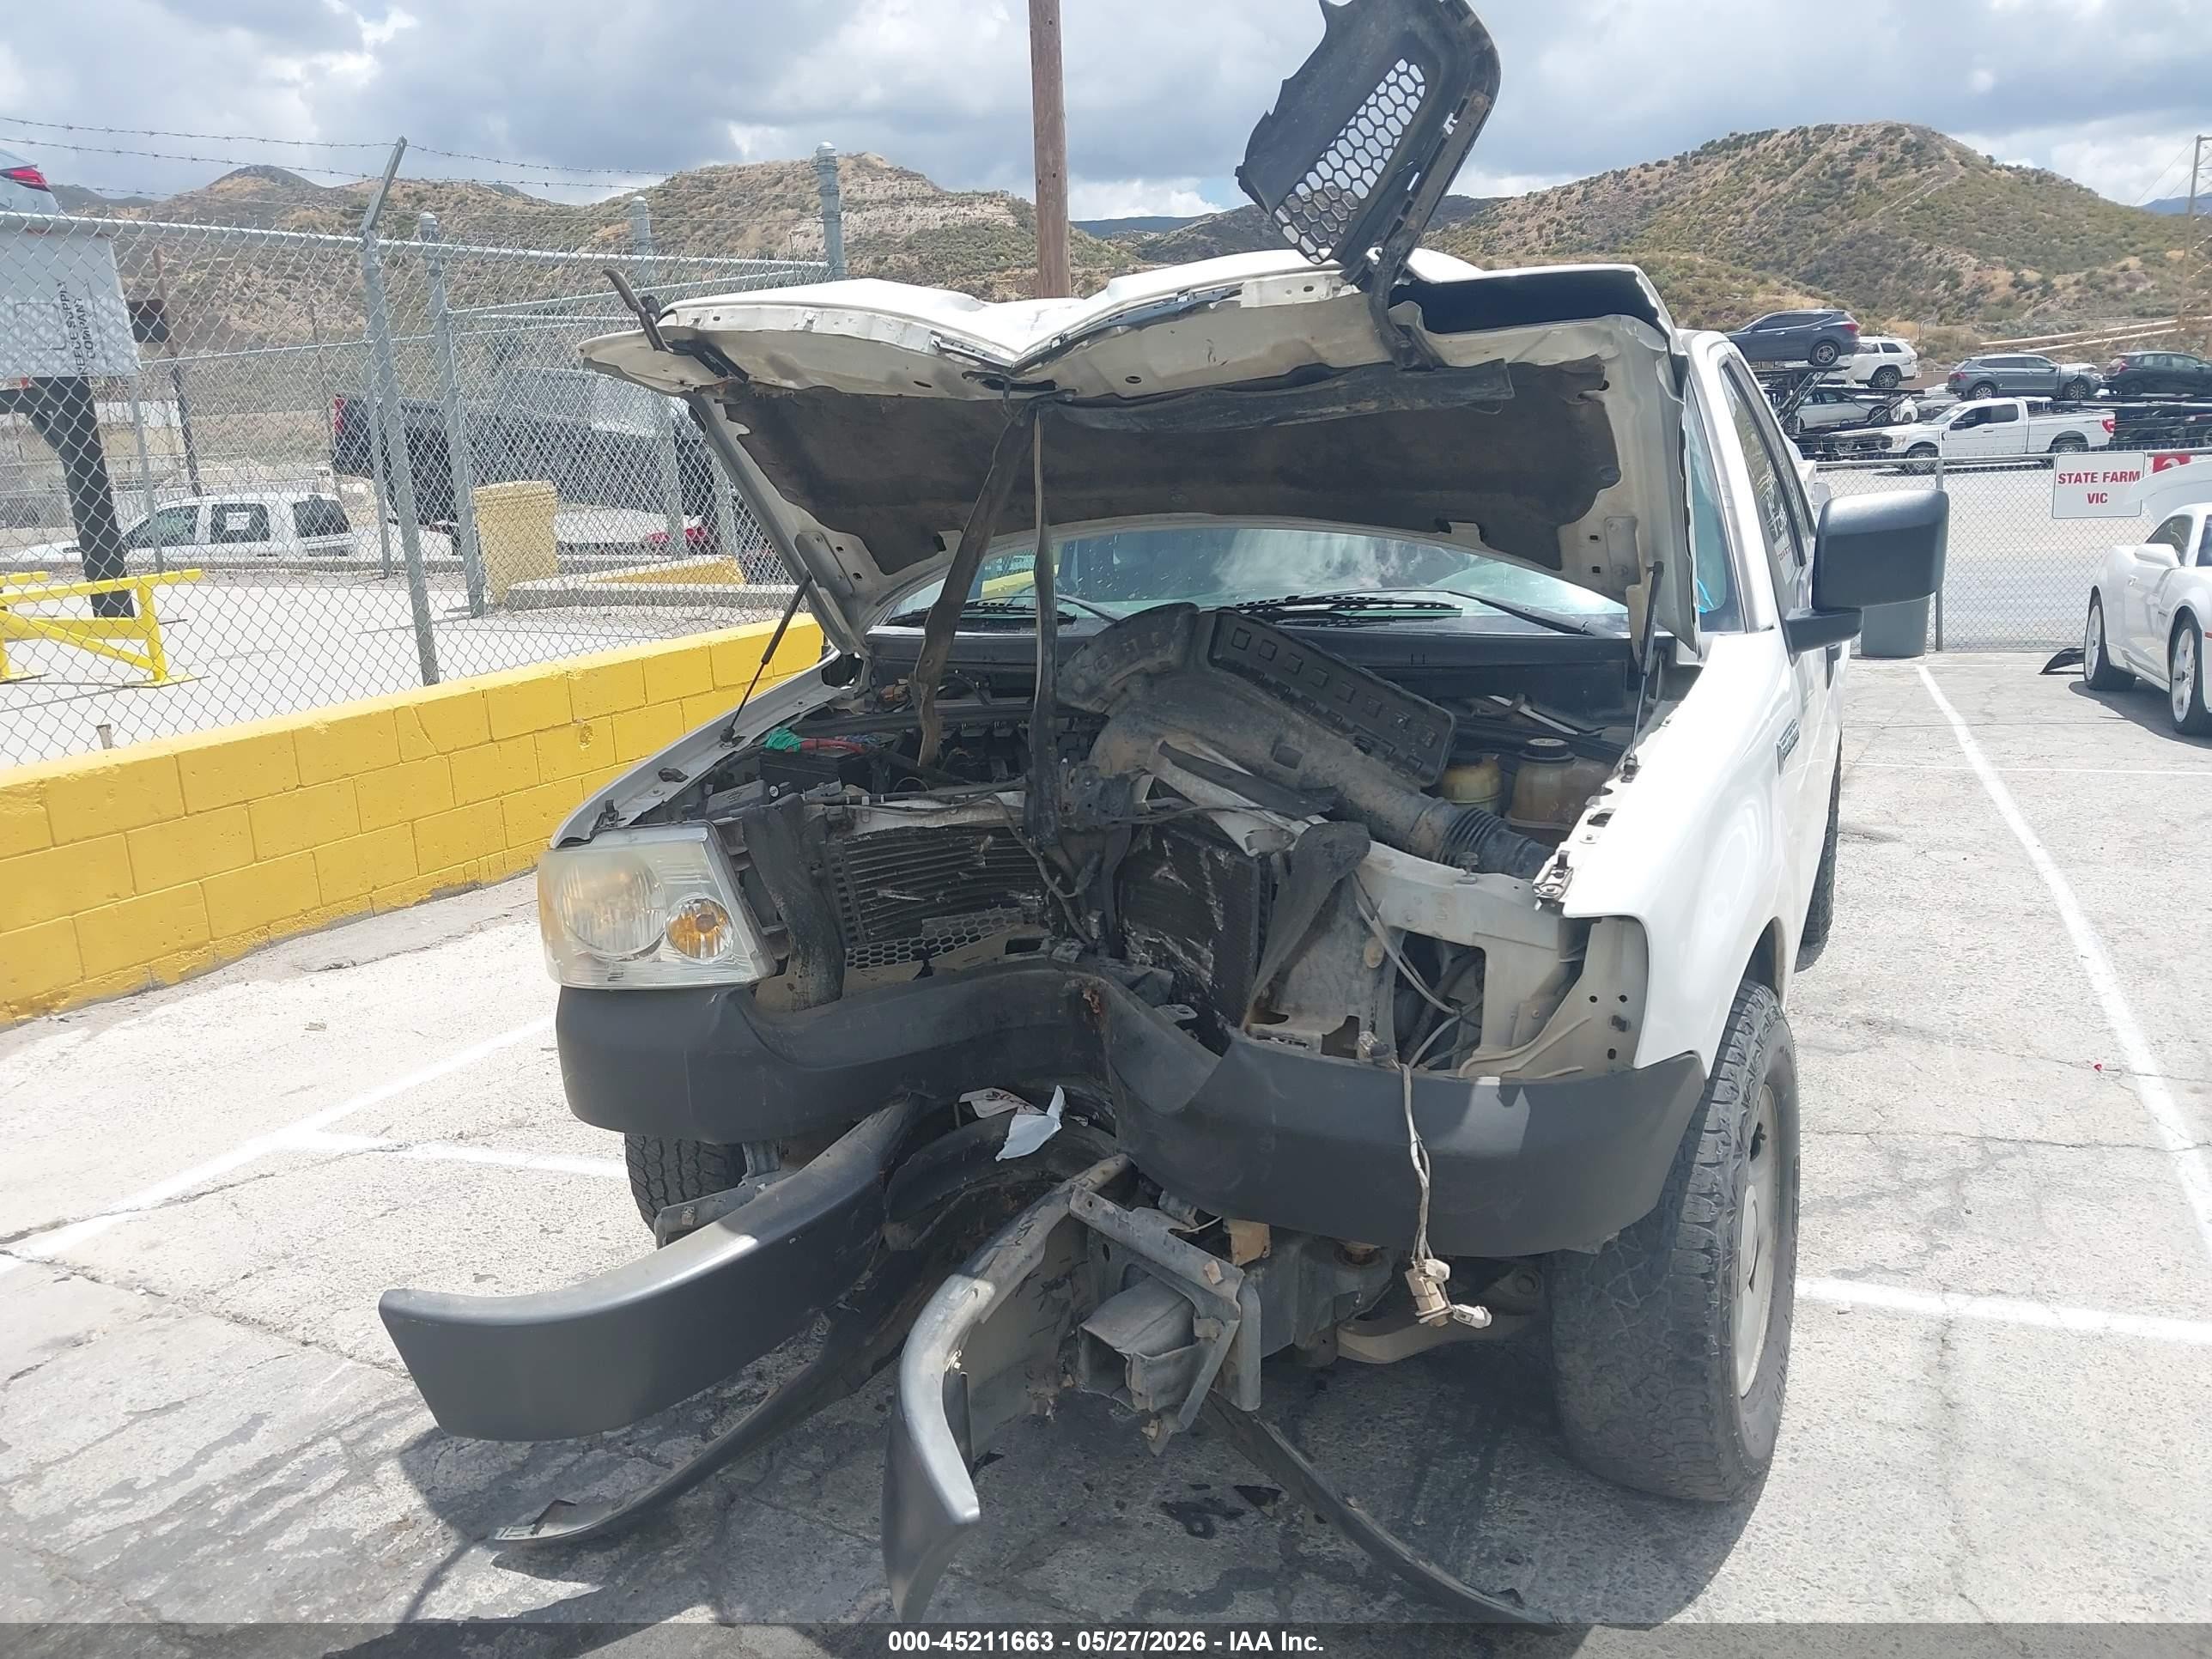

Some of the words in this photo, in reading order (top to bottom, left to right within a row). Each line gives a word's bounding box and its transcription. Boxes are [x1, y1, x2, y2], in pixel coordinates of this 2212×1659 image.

[2057, 471, 2099, 485] STATE
[2102, 471, 2141, 483] FARM
[2087, 492, 2109, 504] VIC
